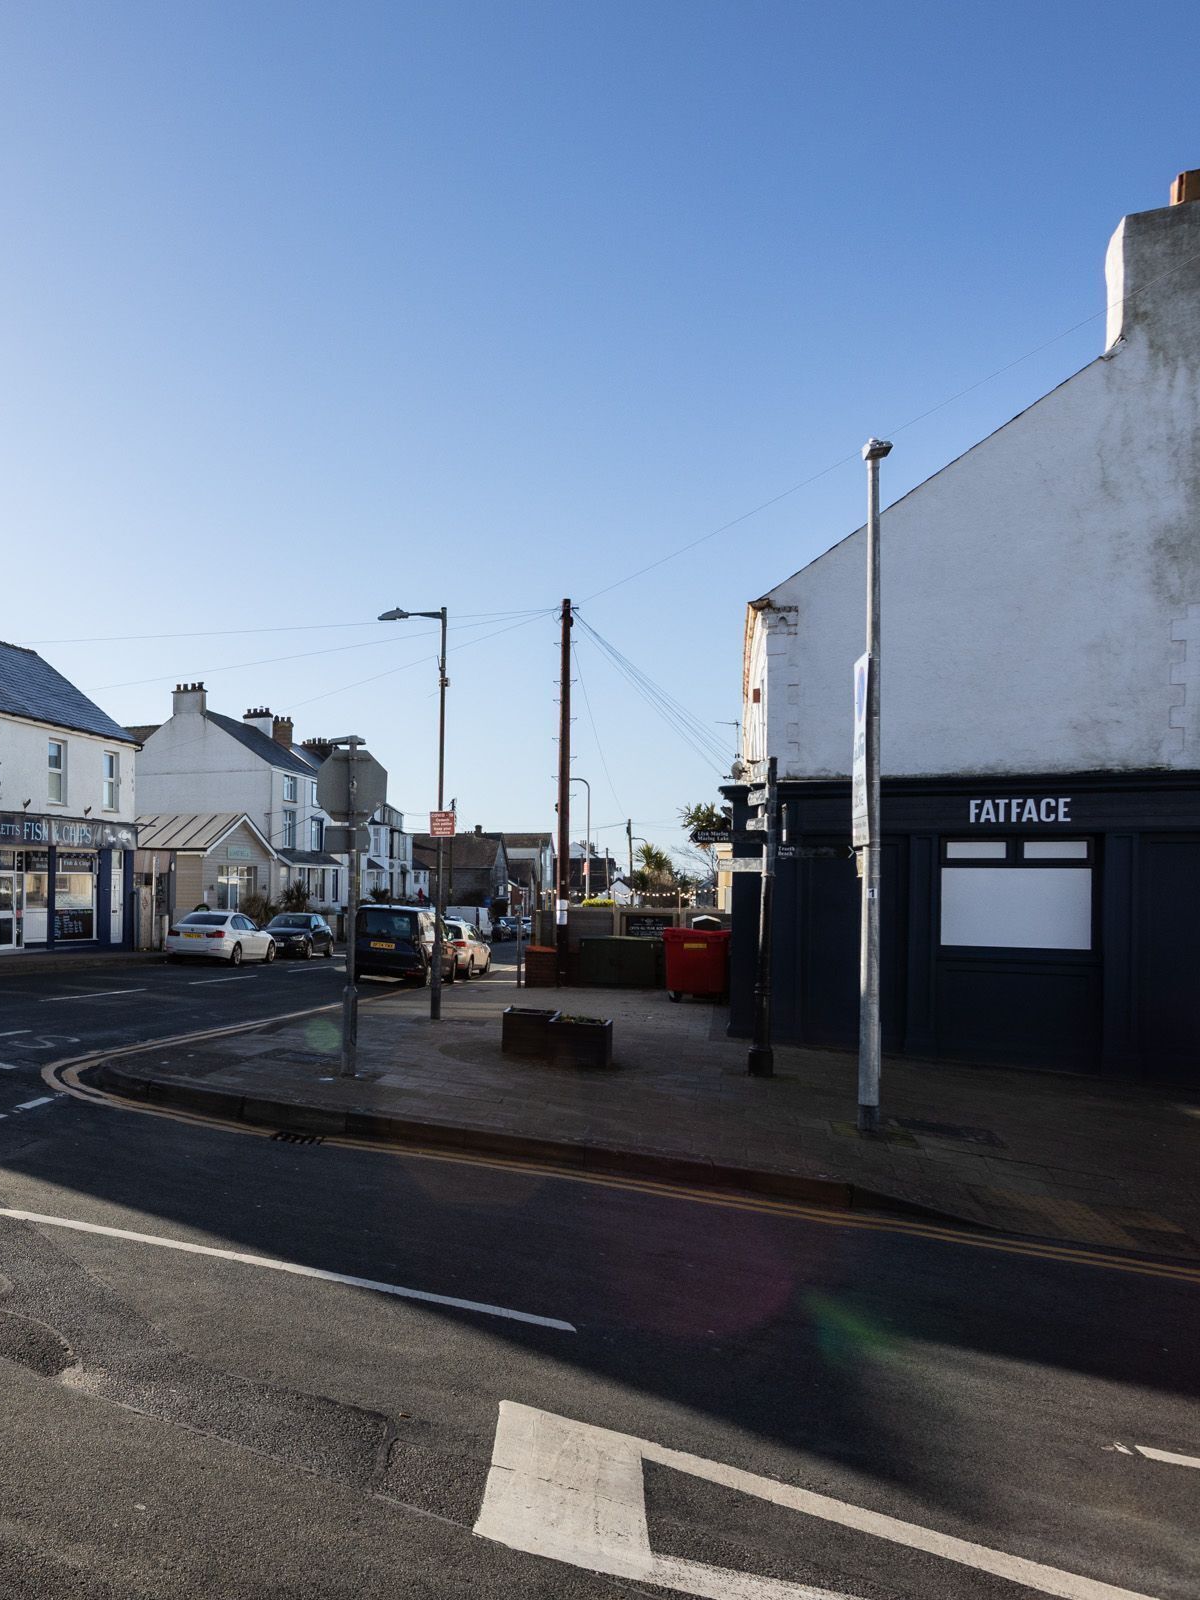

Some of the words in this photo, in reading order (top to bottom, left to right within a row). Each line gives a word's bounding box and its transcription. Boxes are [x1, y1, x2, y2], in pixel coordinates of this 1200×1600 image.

[969, 797, 1072, 823] FATFACE
[23, 822, 49, 841] FISH
[51, 825, 60, 842] &
[62, 825, 92, 844] CHIPS
